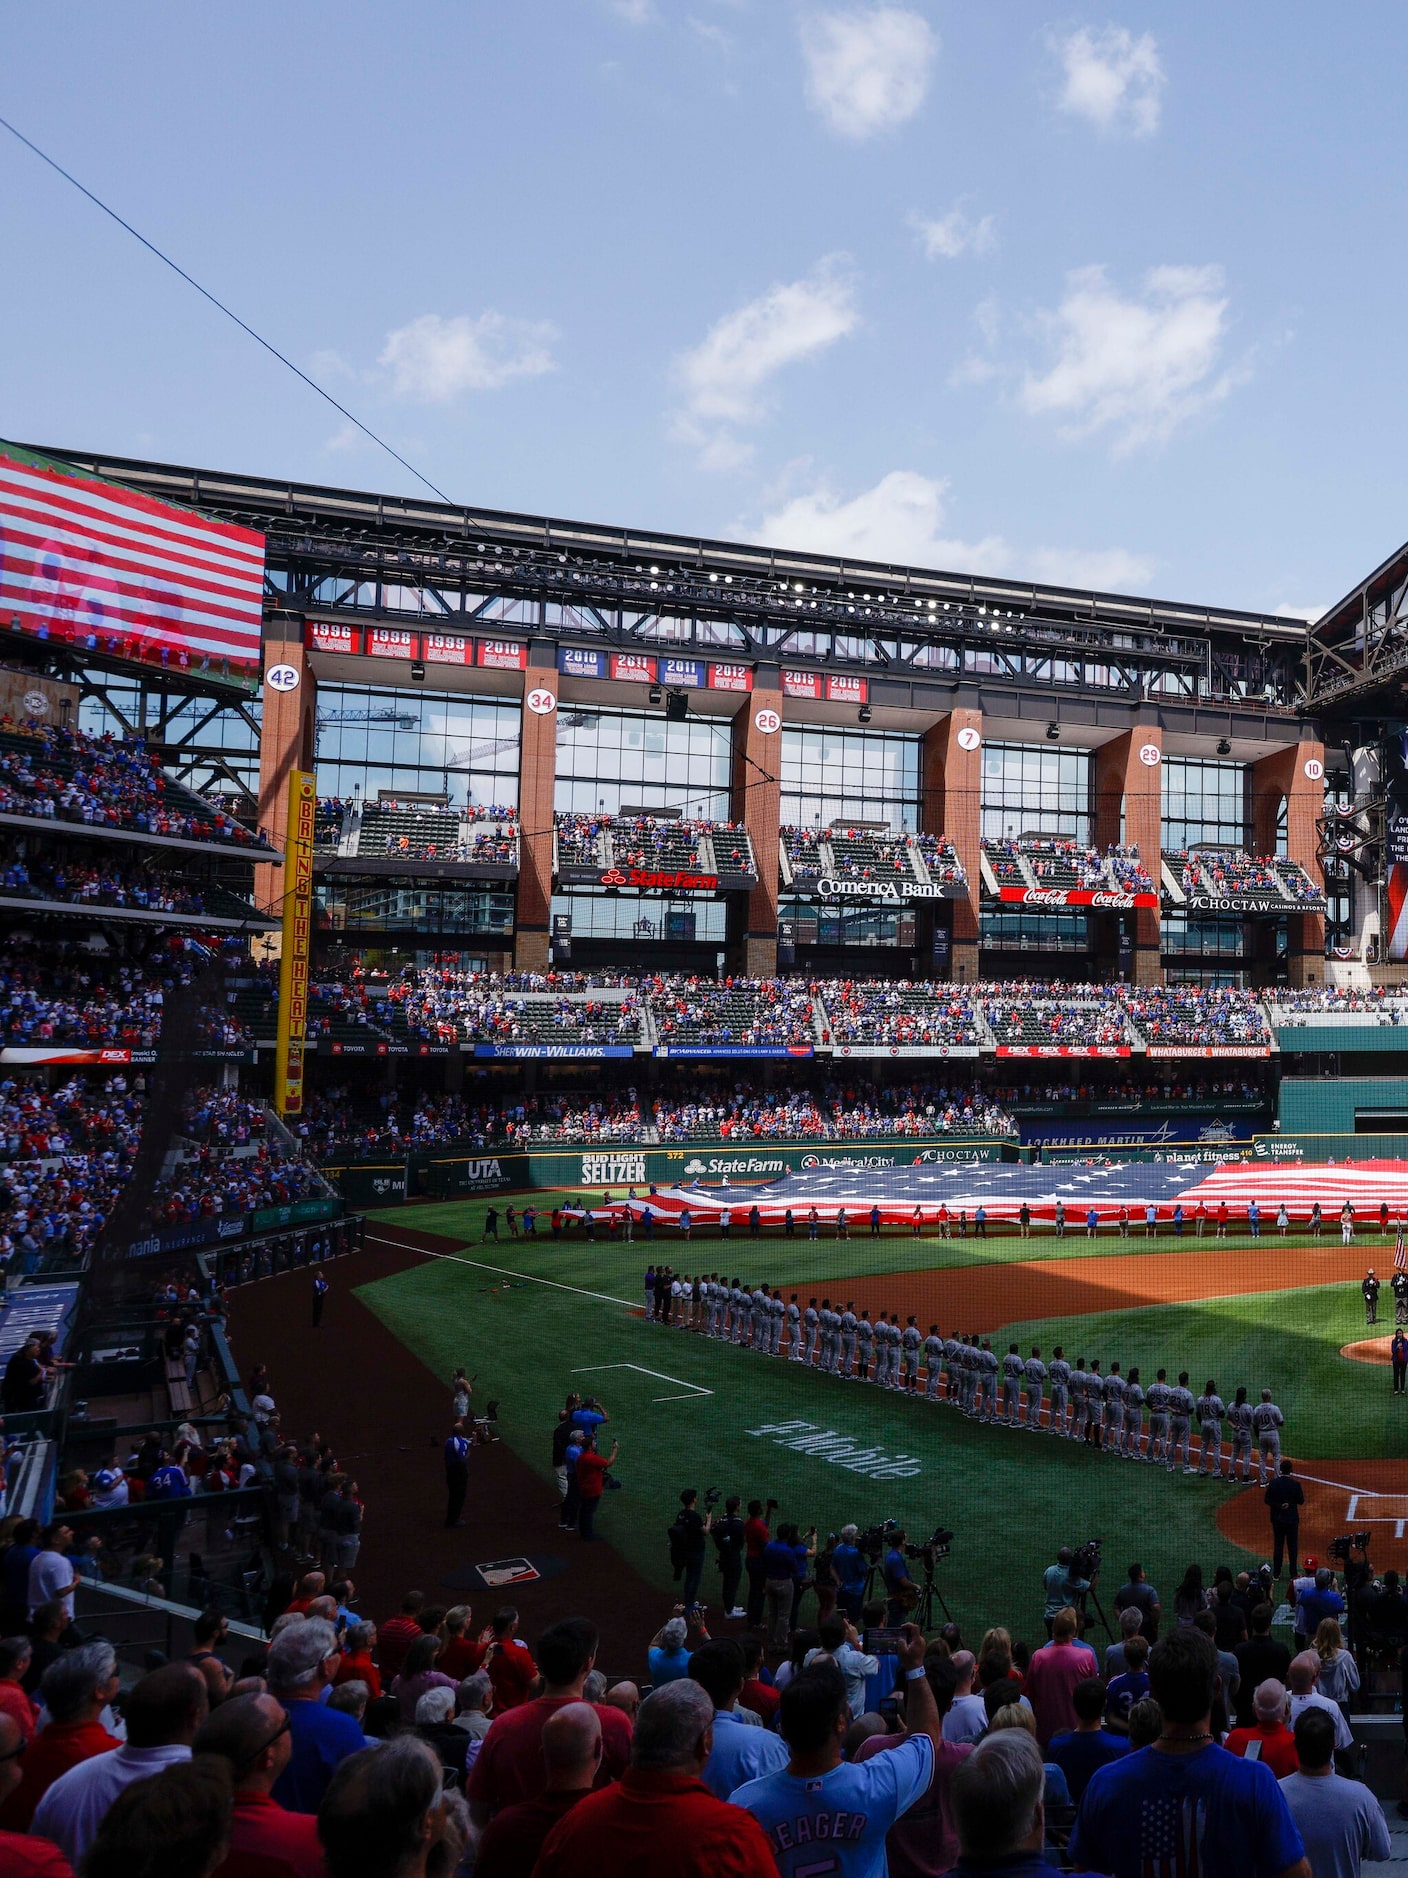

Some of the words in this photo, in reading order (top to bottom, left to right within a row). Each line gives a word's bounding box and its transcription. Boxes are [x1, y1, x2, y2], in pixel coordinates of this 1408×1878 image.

[312, 623, 352, 639] 1996
[372, 629, 411, 645] 1998
[427, 635, 466, 650] 1999
[485, 641, 520, 655] 2010
[565, 650, 597, 664] 2010
[618, 655, 648, 669] 2011
[667, 660, 696, 674] 2011
[715, 664, 746, 678] 2012
[270, 670, 295, 686] 42
[785, 671, 815, 685] 2015
[831, 676, 860, 690] 2016
[531, 694, 552, 708] 34
[758, 715, 777, 728] 26
[965, 733, 974, 746] 7
[1142, 749, 1158, 762] 29
[1308, 764, 1319, 776] 10
[298, 800, 312, 894] BRING
[901, 881, 945, 898] Bank
[1198, 897, 1271, 912] CHOCTAW
[296, 901, 308, 954] THE
[291, 967, 305, 1036] HEAT
[1150, 1048, 1207, 1056] WHATABURGER
[1211, 1048, 1267, 1056] WHATABURGER
[1027, 1137, 1091, 1147] LOCKHEED
[1098, 1135, 1145, 1145] MARTIN
[582, 1154, 609, 1164] BUD
[610, 1154, 646, 1163] LIGHT
[667, 1152, 684, 1160] 372
[1166, 1152, 1201, 1163] planet
[1203, 1151, 1240, 1161] fitness
[468, 1159, 502, 1179] UTA
[582, 1162, 646, 1185] SELTZER
[153, 1473, 171, 1489] 34
[773, 1811, 867, 1854] EAGER
